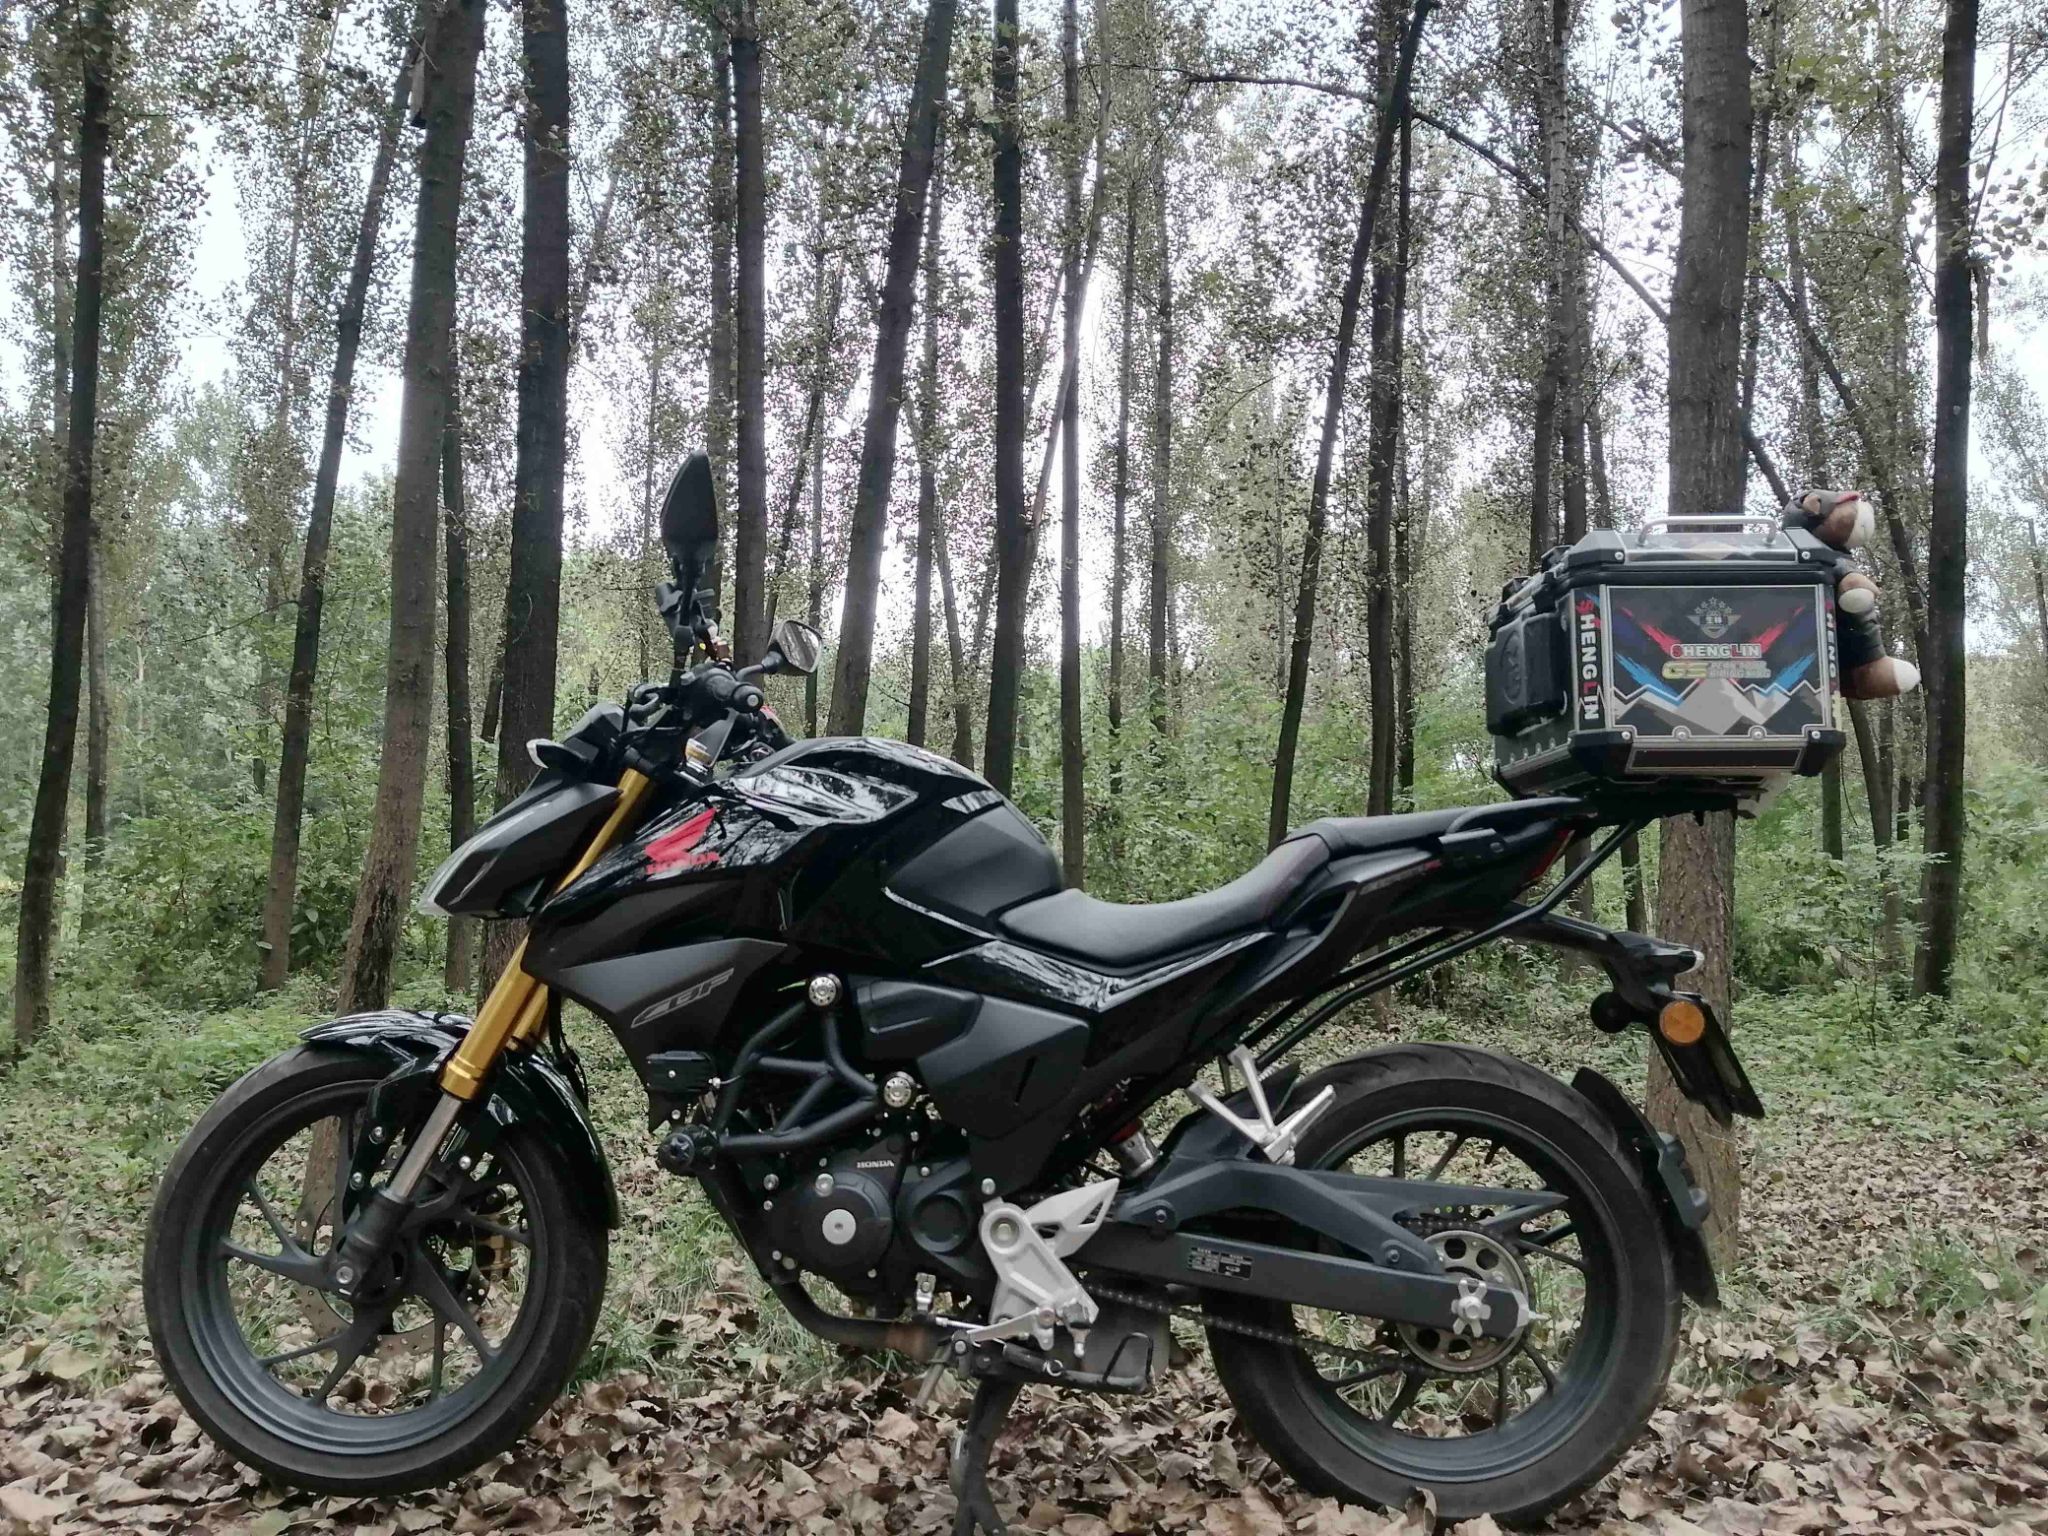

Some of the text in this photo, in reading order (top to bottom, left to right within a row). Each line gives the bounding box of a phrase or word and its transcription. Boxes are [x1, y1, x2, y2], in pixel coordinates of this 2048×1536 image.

[1670, 643, 1761, 659] SHENGLIN
[1577, 600, 1604, 720] SHENGLIN
[856, 1159, 896, 1169] HONDA
